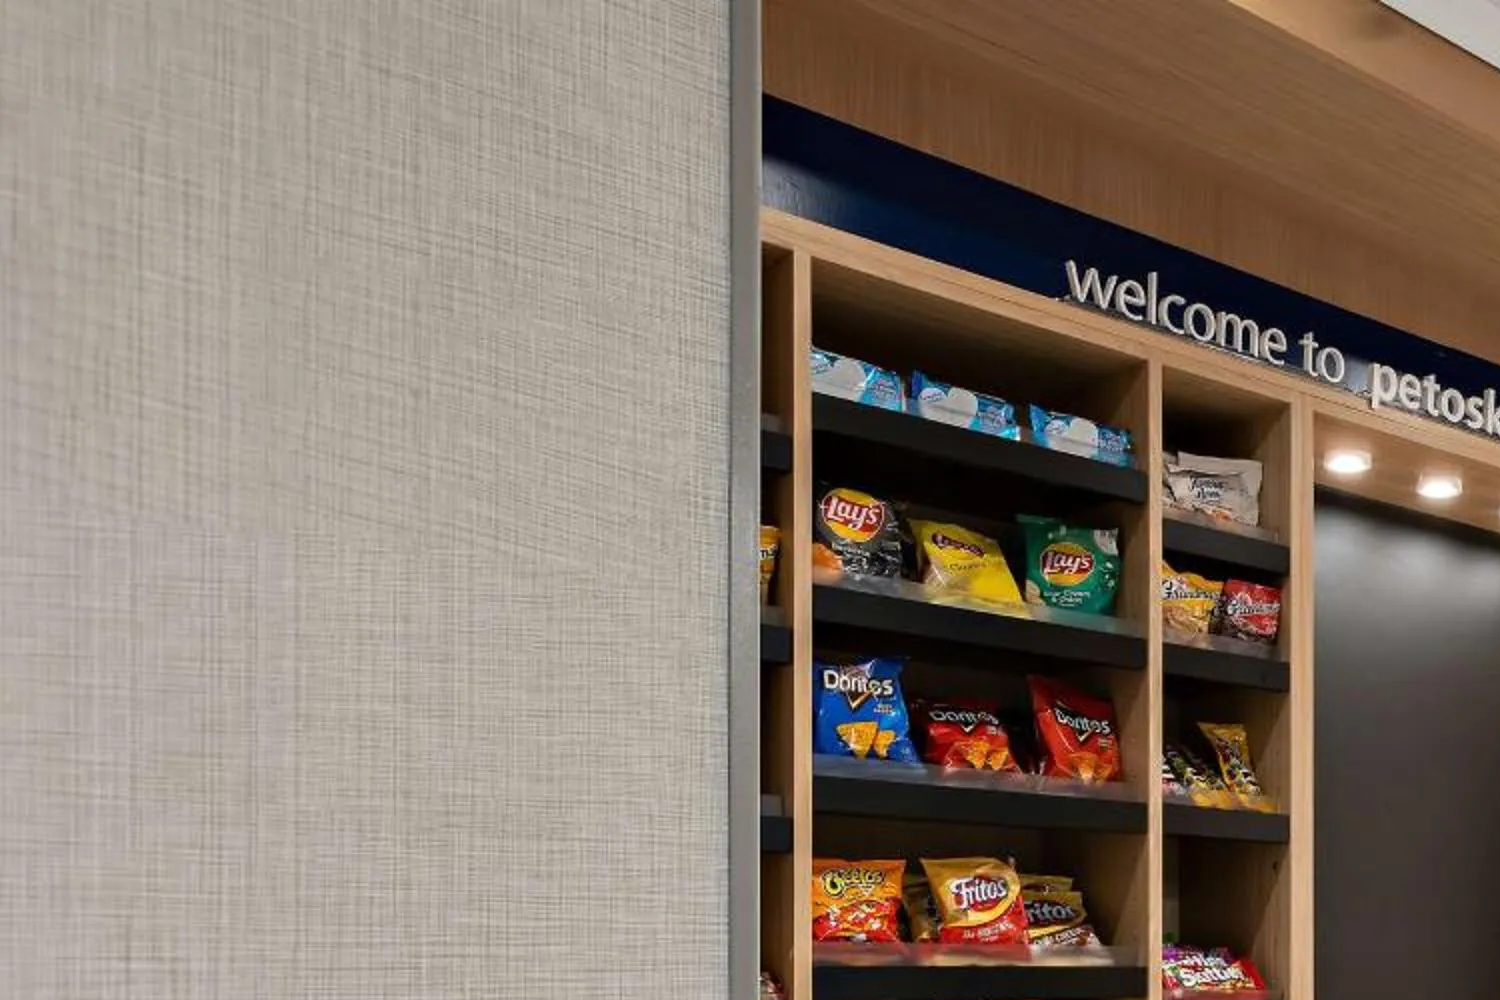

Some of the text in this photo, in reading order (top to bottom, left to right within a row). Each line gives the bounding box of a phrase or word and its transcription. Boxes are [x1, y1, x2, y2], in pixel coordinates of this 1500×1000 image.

[1065, 259, 1288, 365] welcome
[1299, 330, 1344, 384] to
[1043, 551, 1092, 576] Lay's
[823, 670, 894, 695] Doritos
[950, 879, 1007, 910] Fritos
[1025, 902, 1075, 922] ritos
